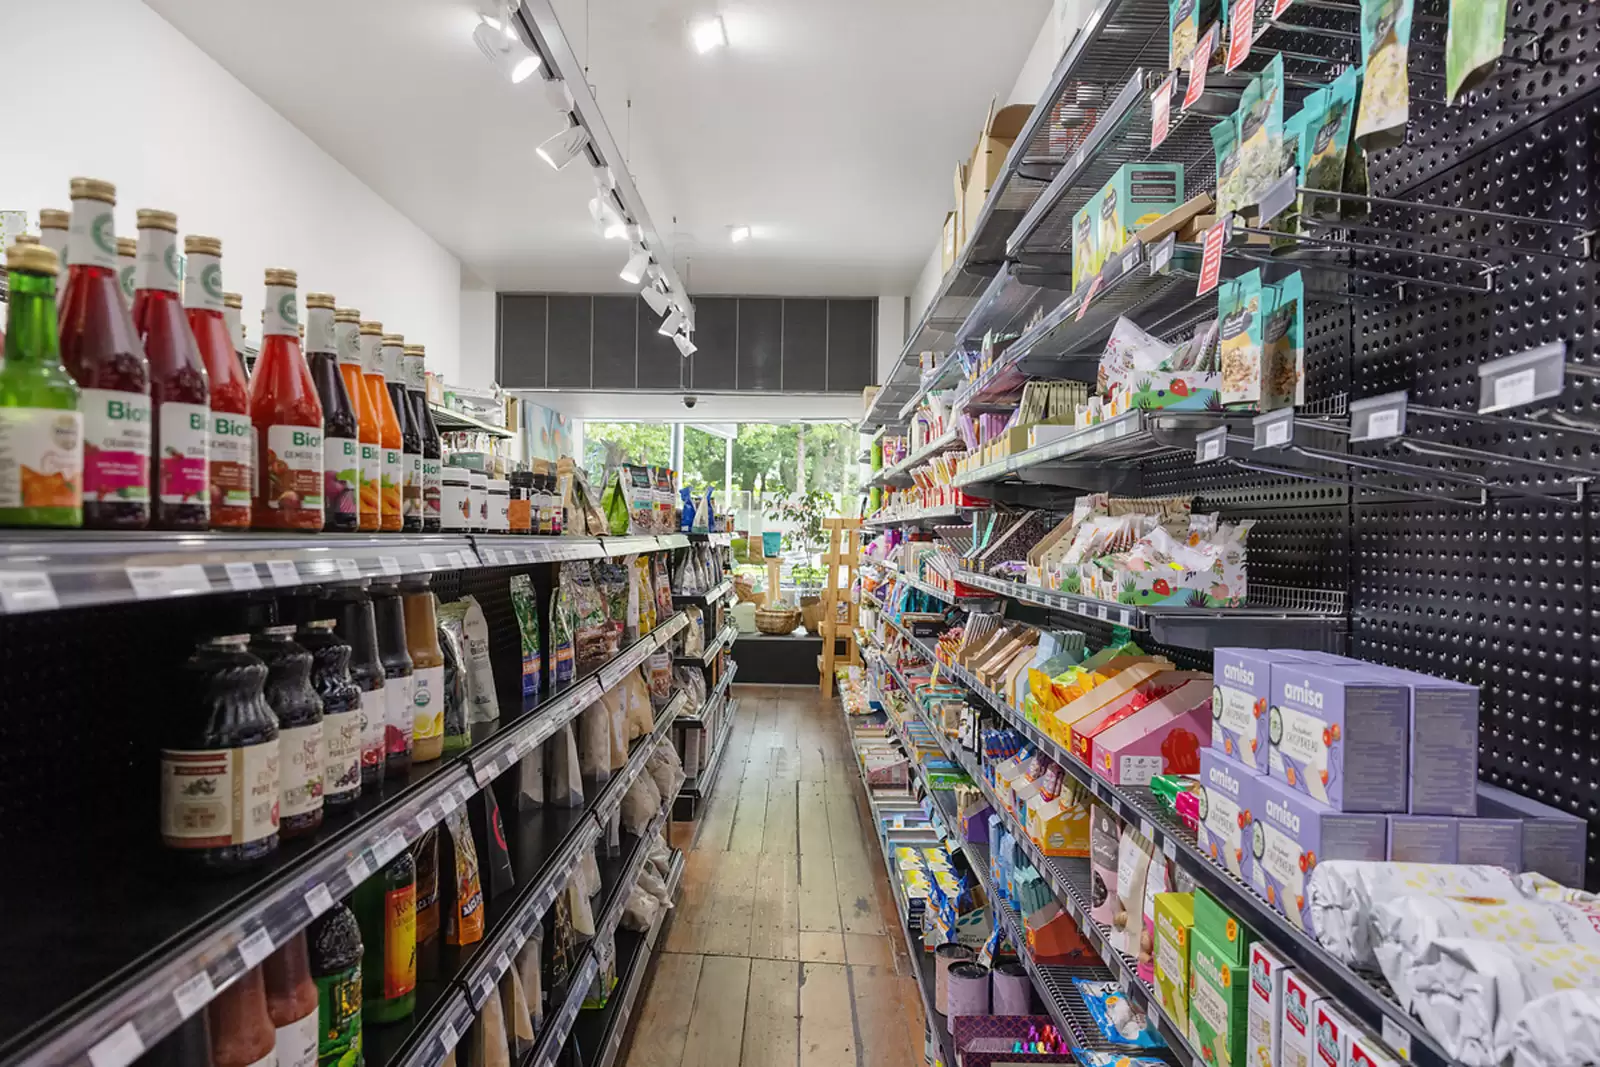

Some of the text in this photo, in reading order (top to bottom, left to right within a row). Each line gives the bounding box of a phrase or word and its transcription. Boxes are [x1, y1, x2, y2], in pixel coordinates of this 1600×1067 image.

[1224, 660, 1255, 686] amisa
[1284, 680, 1323, 709] amisa
[1209, 767, 1239, 795] amisa
[1266, 800, 1300, 833] amisa
[1158, 911, 1183, 945] amis
